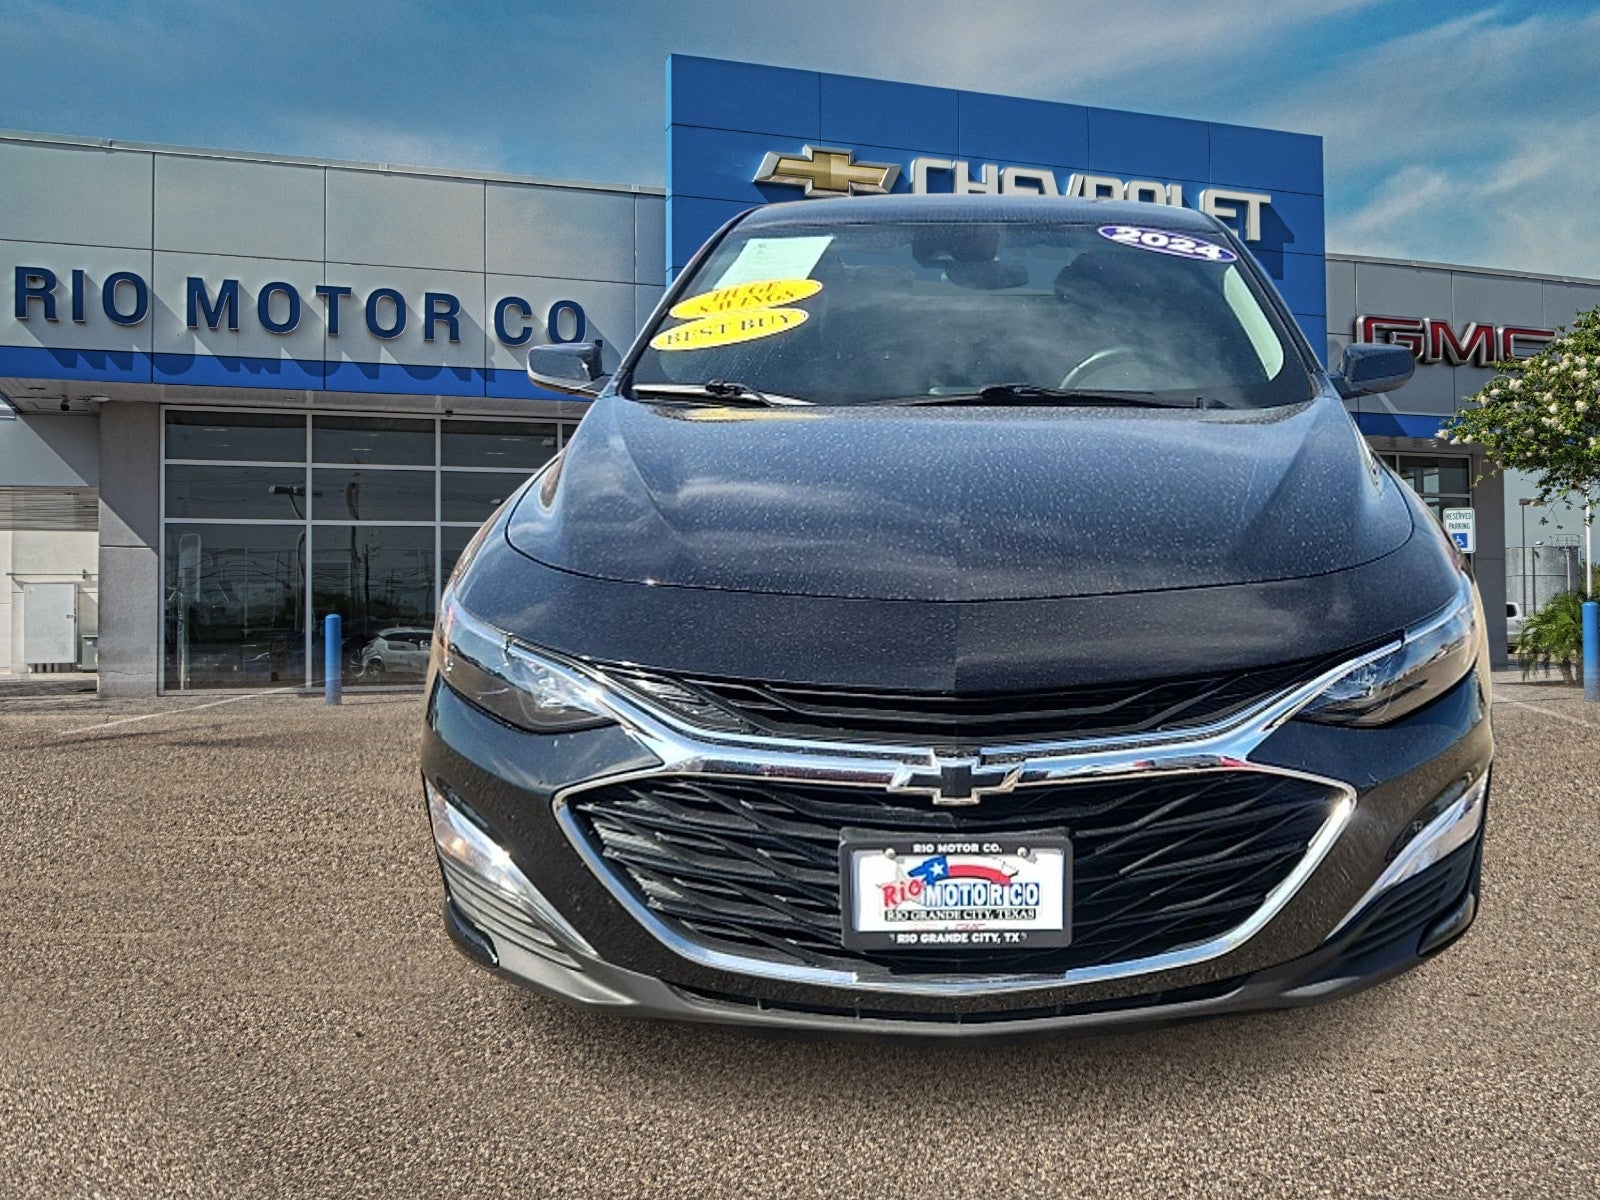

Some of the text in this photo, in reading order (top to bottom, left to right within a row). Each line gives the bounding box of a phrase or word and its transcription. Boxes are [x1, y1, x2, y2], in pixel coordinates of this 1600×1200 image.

[1112, 227, 1221, 259] 2024
[14, 265, 604, 348] RIO MOTOR CO.
[667, 314, 789, 345] BEST BUY
[1356, 314, 1556, 366] GMC
[912, 843, 1003, 853] RIO MOTOR CO.
[925, 882, 1005, 908] MOTOR
[1009, 882, 1040, 907] CO
[886, 909, 909, 921] RIO
[910, 909, 961, 921] GRANDE
[997, 909, 1035, 921] TEXAS
[897, 932, 917, 943] RIO
[920, 932, 968, 944] GRANDE
[1004, 931, 1021, 942] TX
